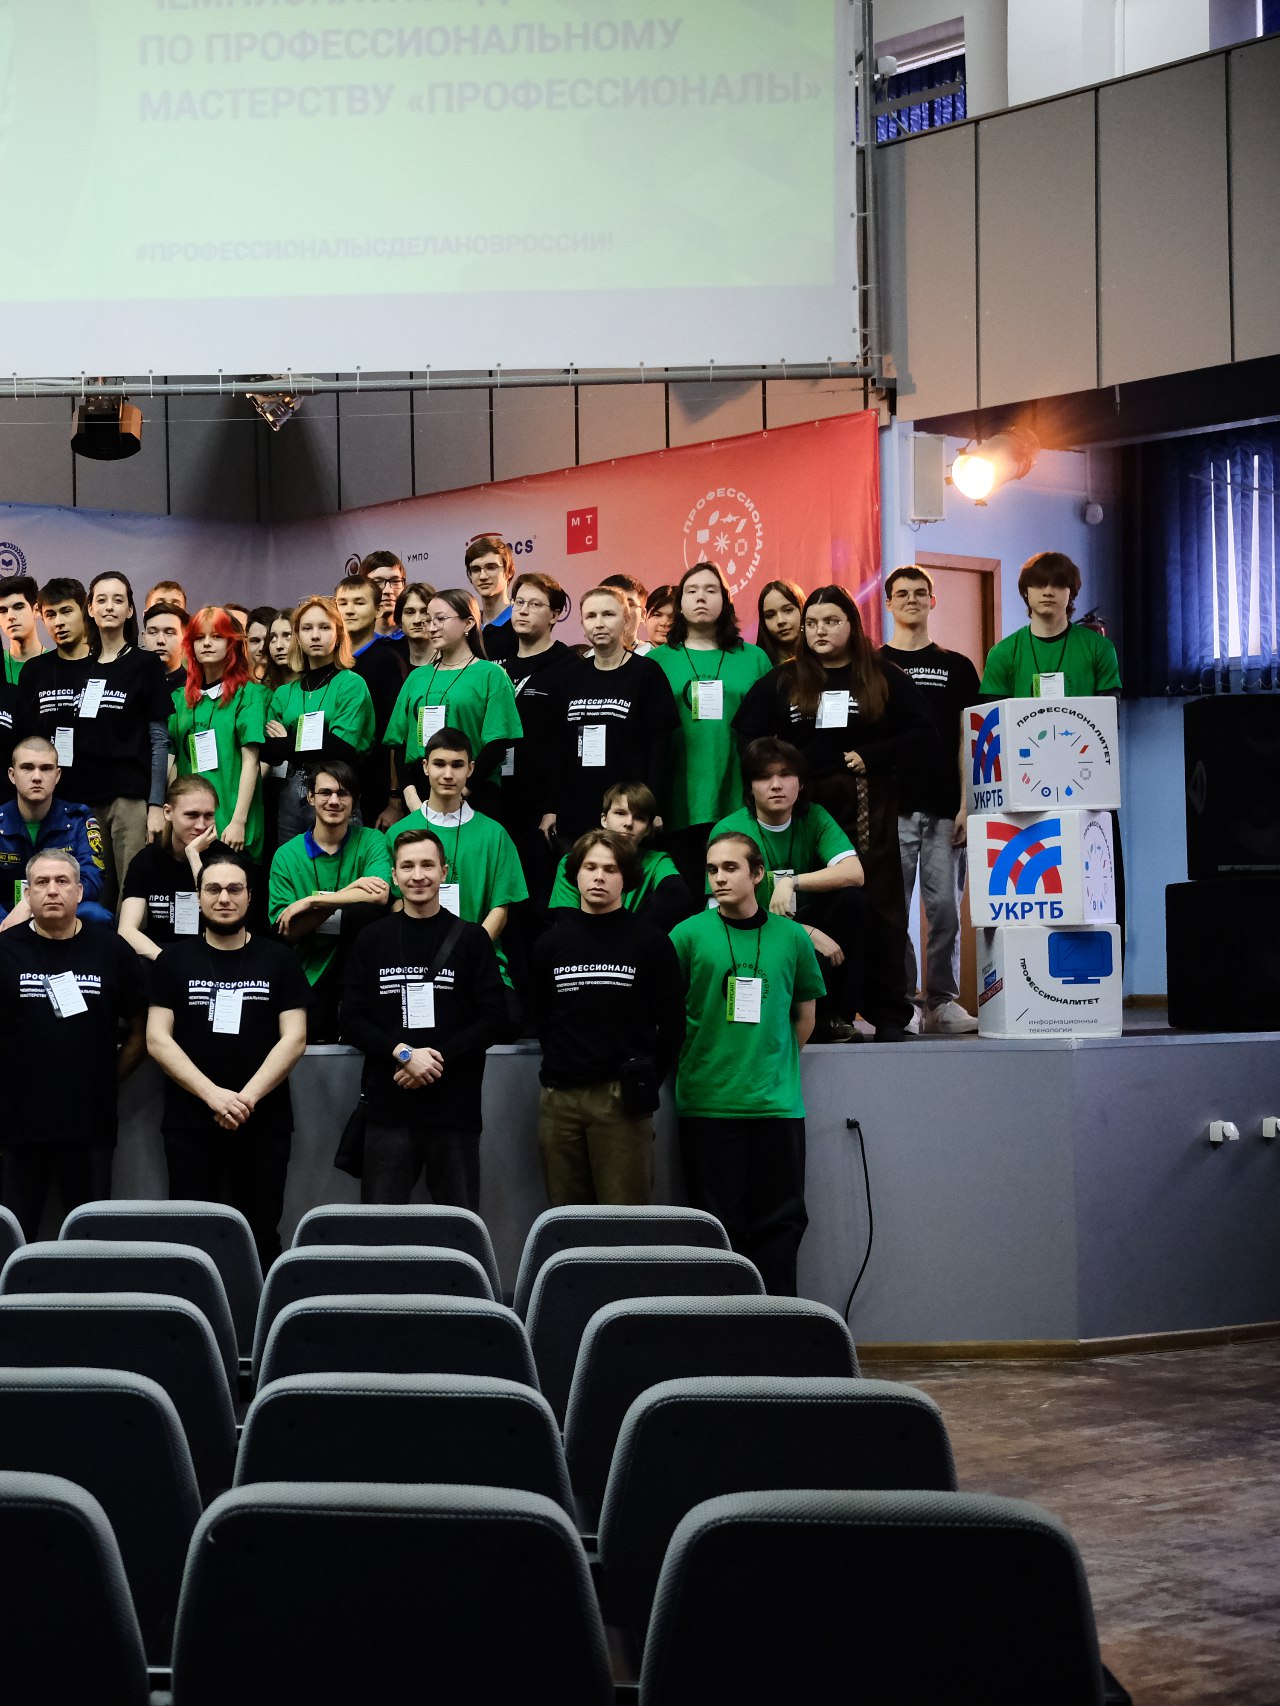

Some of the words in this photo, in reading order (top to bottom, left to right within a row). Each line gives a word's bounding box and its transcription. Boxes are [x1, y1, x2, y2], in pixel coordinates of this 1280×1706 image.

[139, 33, 194, 66] ПО
[205, 18, 683, 65] ПРОФЕССИОНАЛЬНОМУ
[138, 82, 395, 122] МАСТЕРСТВУ
[407, 72, 822, 115] «ПРОФЕССИОНАЛЫ»
[134, 232, 613, 263] #ПРОФЕССИОНАЛЫСДЕЛАНОВРОССИИ!
[683, 488, 763, 596] ПРОФЕССИОНАЛИТЕ
[407, 552, 429, 563] УМПО
[904, 667, 949, 677] ССИОНАЛЫ
[1016, 706, 1111, 765] ПРОФЕССИОНАЛИТЕТ
[974, 789, 1004, 810] УКРТБ
[989, 901, 1064, 920] УКРТБ
[553, 964, 637, 975] ПРОФЕССИОНАЛЫ
[1020, 957, 1100, 1005] ПРОФЕССИОНАЛИТЕТ
[1028, 1018, 1099, 1026] информационные
